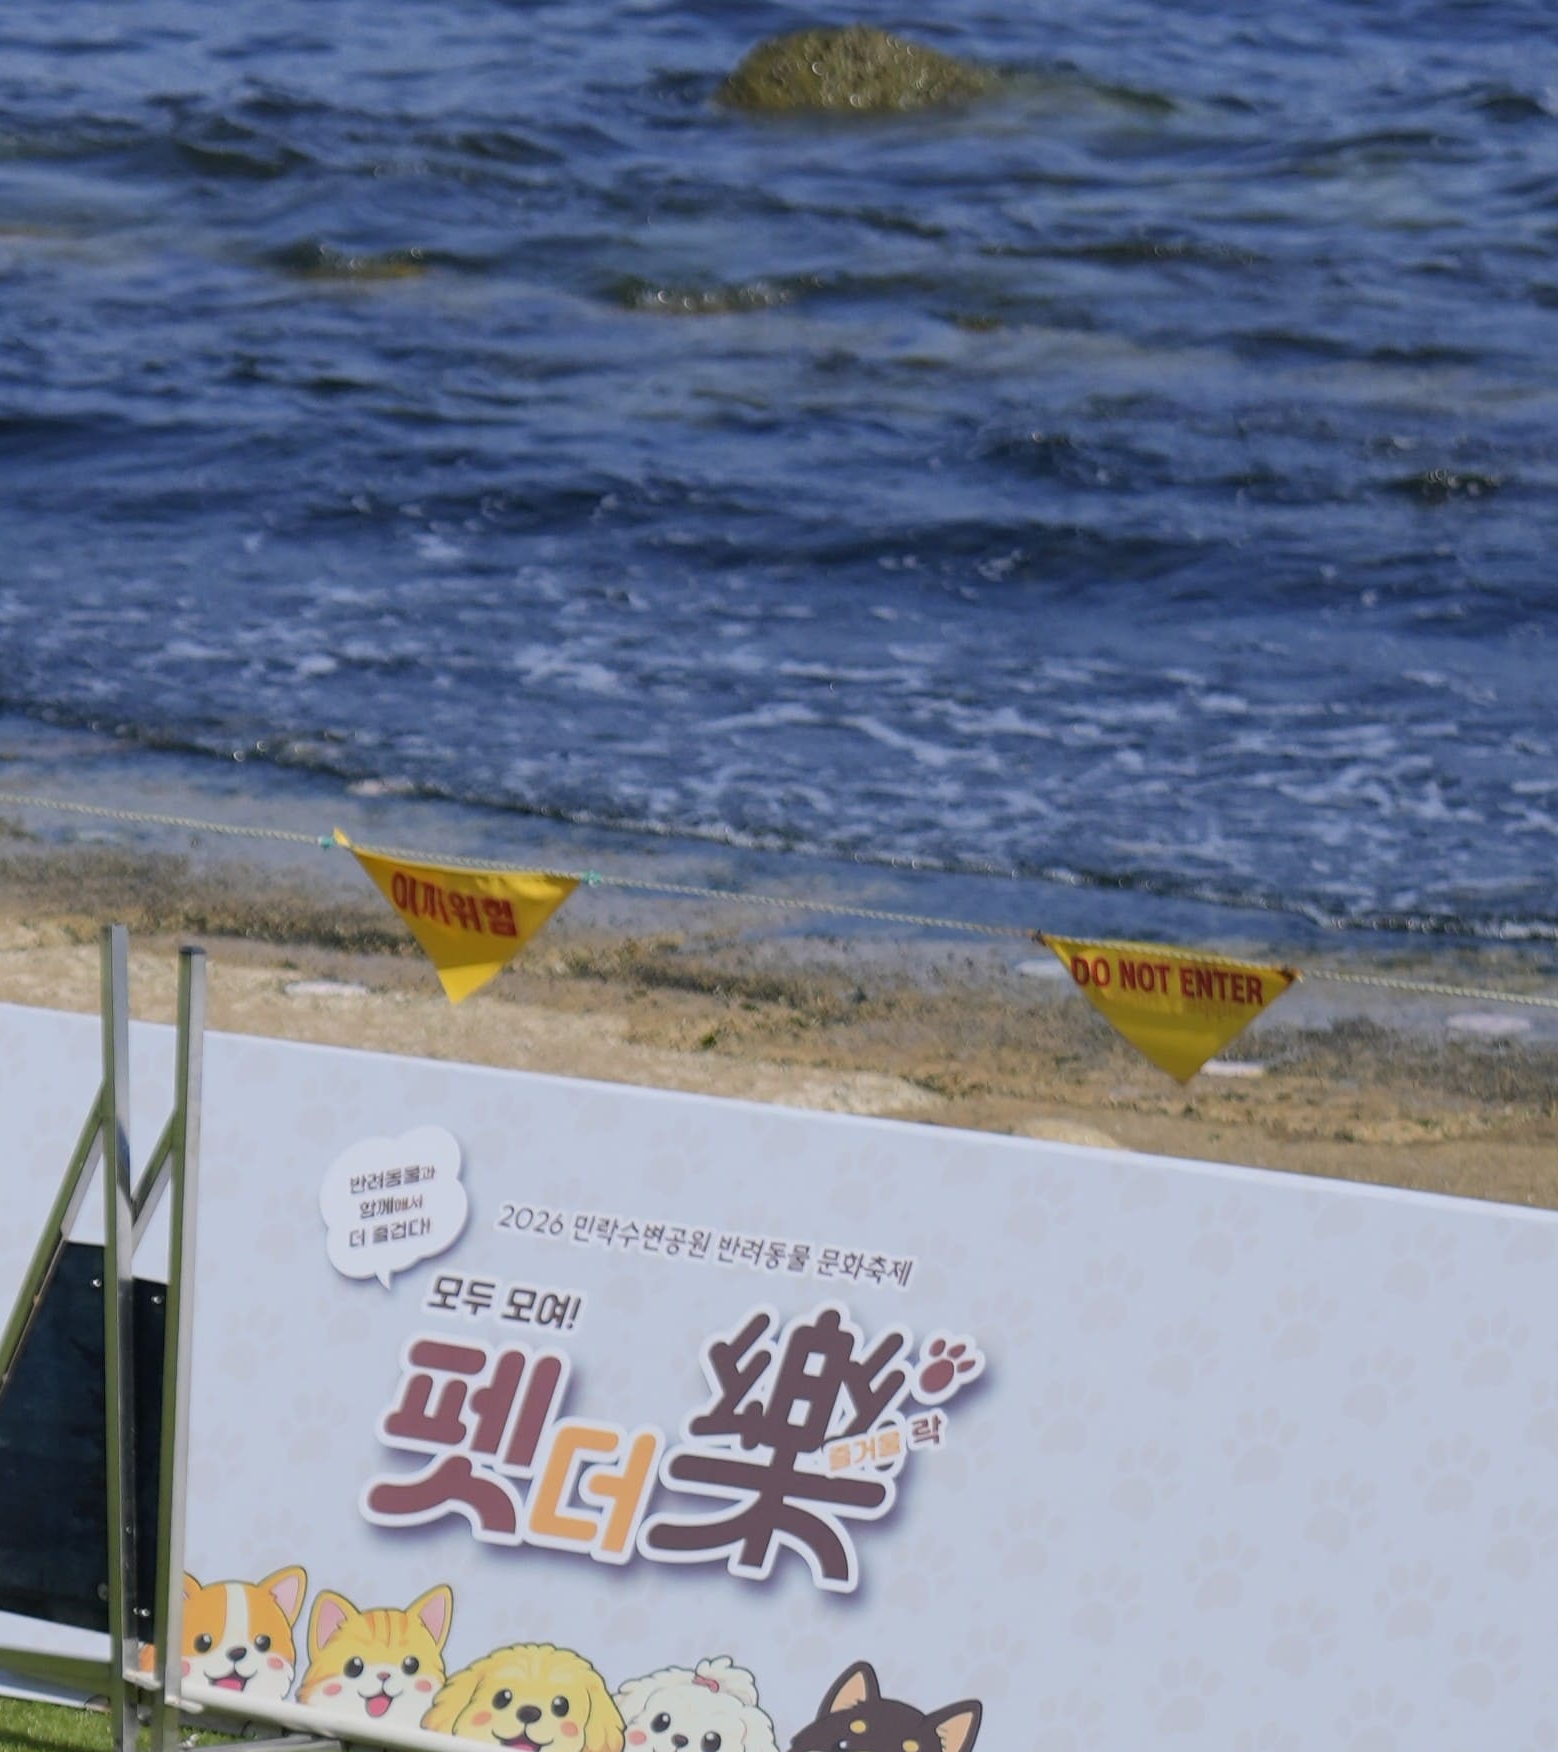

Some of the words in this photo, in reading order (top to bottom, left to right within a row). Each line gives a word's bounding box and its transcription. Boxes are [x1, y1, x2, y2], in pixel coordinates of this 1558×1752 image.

[1070, 956, 1111, 988] DO
[1119, 960, 1171, 995] NOT
[1179, 966, 1263, 1004] ENTER
[349, 1165, 436, 1194] 반려동물과
[359, 1195, 423, 1220] 함께해서
[348, 1229, 365, 1248] 더
[372, 1217, 431, 1244] 즐겁다!
[499, 1204, 564, 1235] 2026
[573, 1213, 712, 1259] 민락수변공원
[718, 1236, 811, 1272] 반려동물
[816, 1248, 914, 1287] 문화축제
[427, 1275, 496, 1315] 모두
[501, 1288, 581, 1329] 모여!
